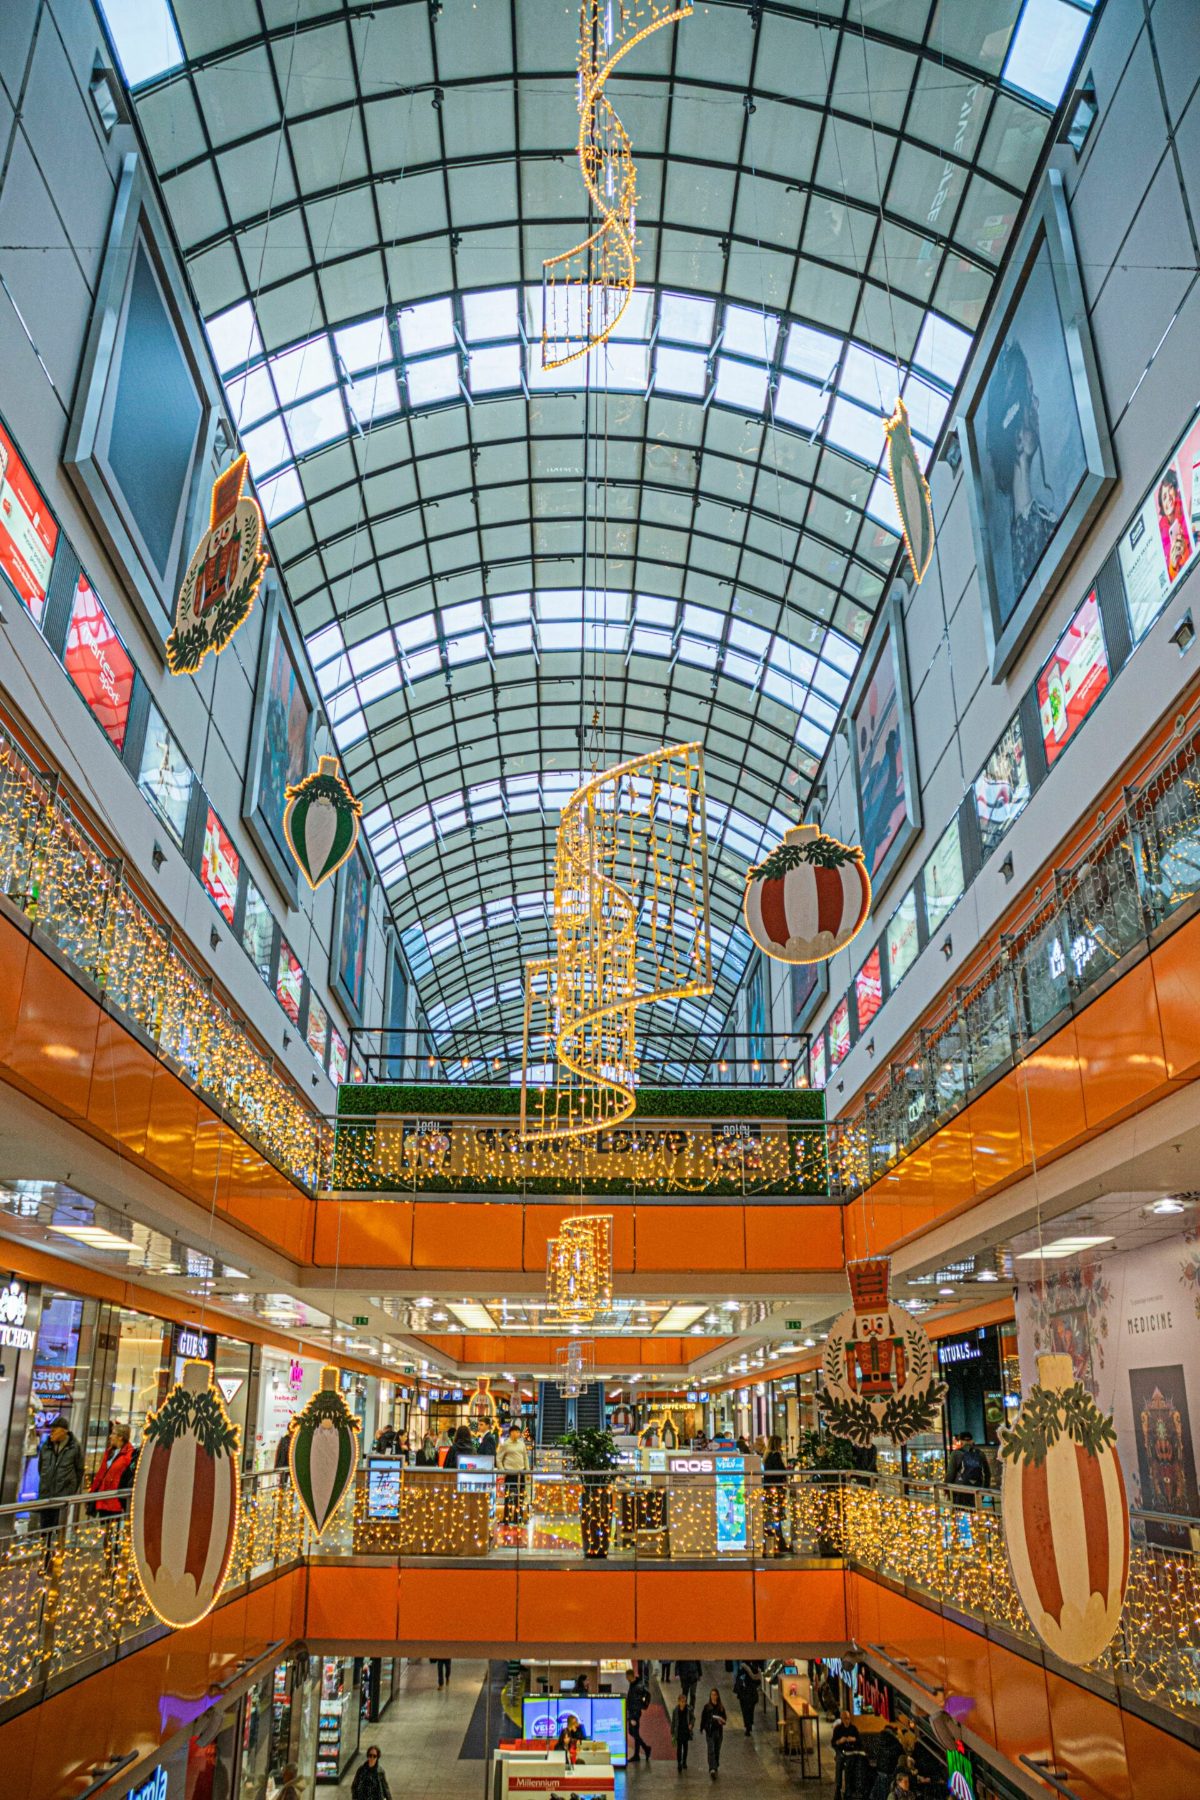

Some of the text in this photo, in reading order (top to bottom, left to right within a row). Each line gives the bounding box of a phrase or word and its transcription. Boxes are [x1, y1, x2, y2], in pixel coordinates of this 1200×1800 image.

[99, 671, 120, 706] sport
[1127, 1311, 1173, 1335] MEDICINE
[180, 1332, 208, 1359] GUESS
[32, 1381, 61, 1391] DAYS
[670, 1460, 713, 1473] IQOS
[534, 1723, 556, 1732] VELO
[516, 1778, 560, 1788] Millennium
